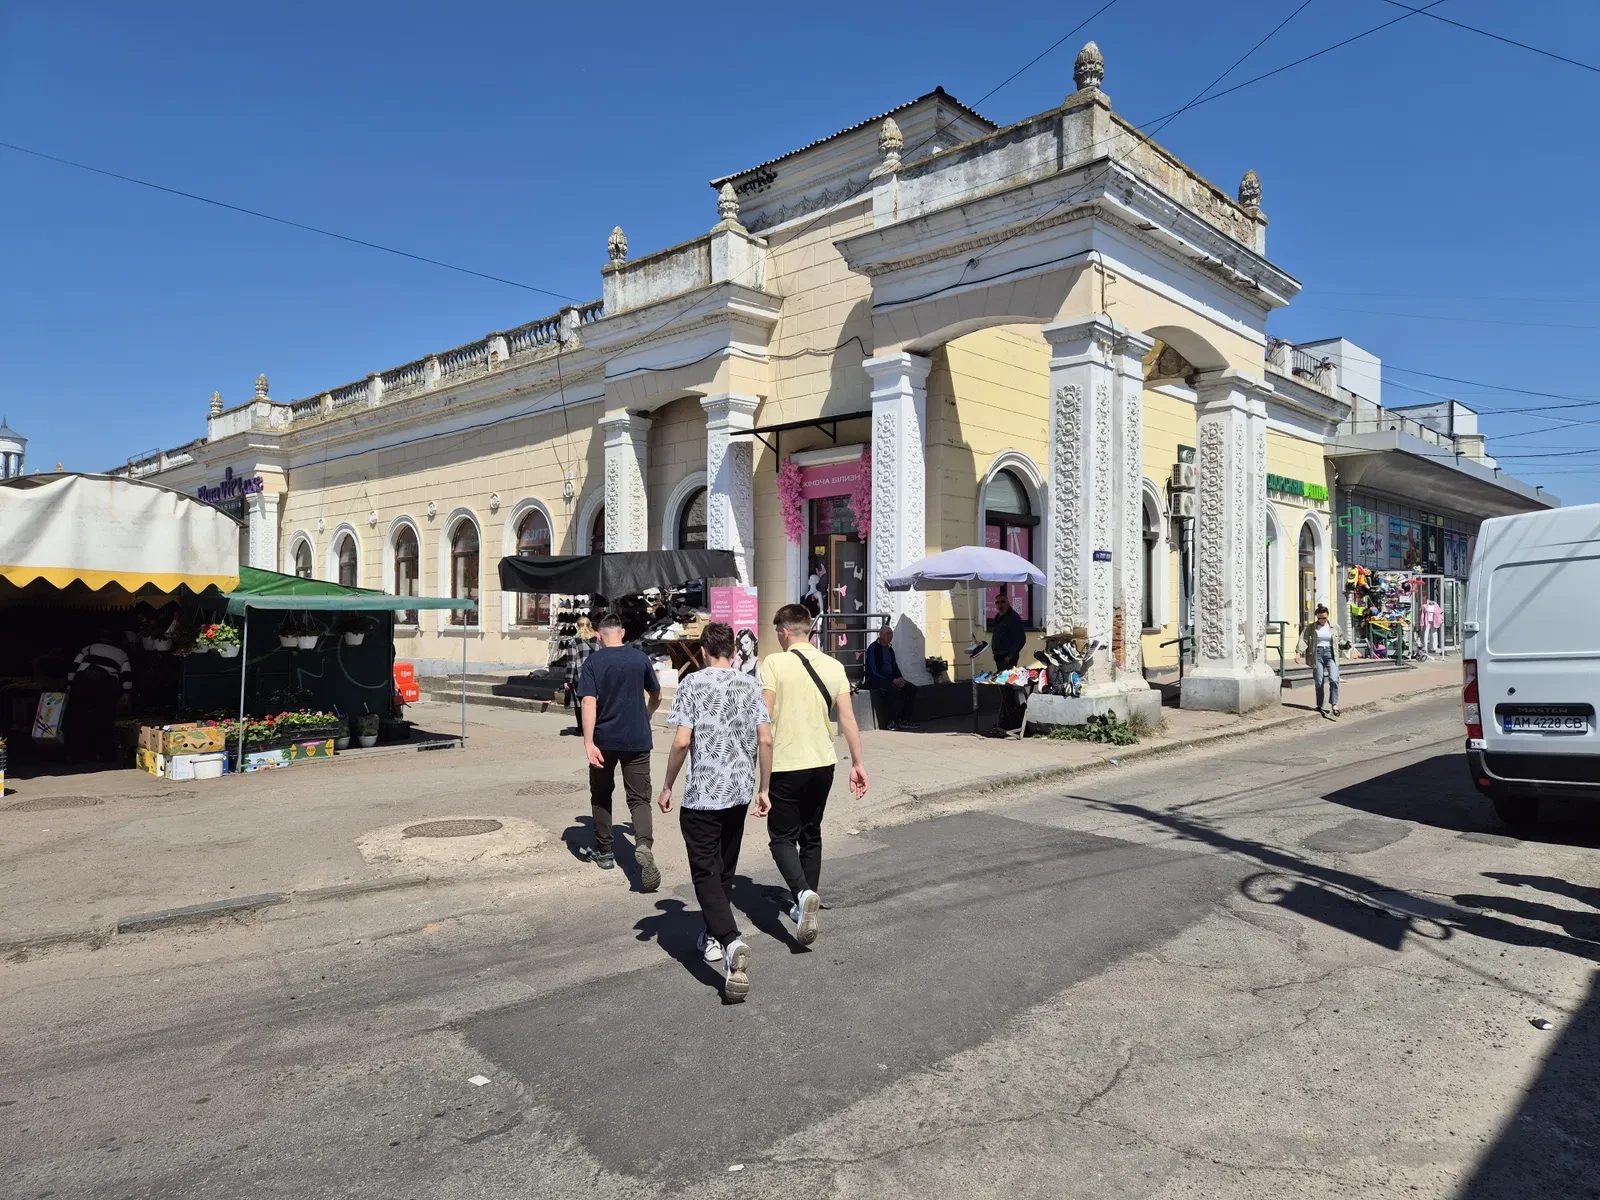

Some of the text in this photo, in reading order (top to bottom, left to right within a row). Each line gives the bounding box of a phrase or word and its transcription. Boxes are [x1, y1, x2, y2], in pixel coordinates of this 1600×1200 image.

[832, 474, 861, 484] БІЛИЗН
[1266, 473, 1305, 497] ОДОРОЖНИК
[1513, 717, 1531, 729] AM
[1533, 717, 1562, 729] 4228
[1564, 717, 1583, 729] CB
